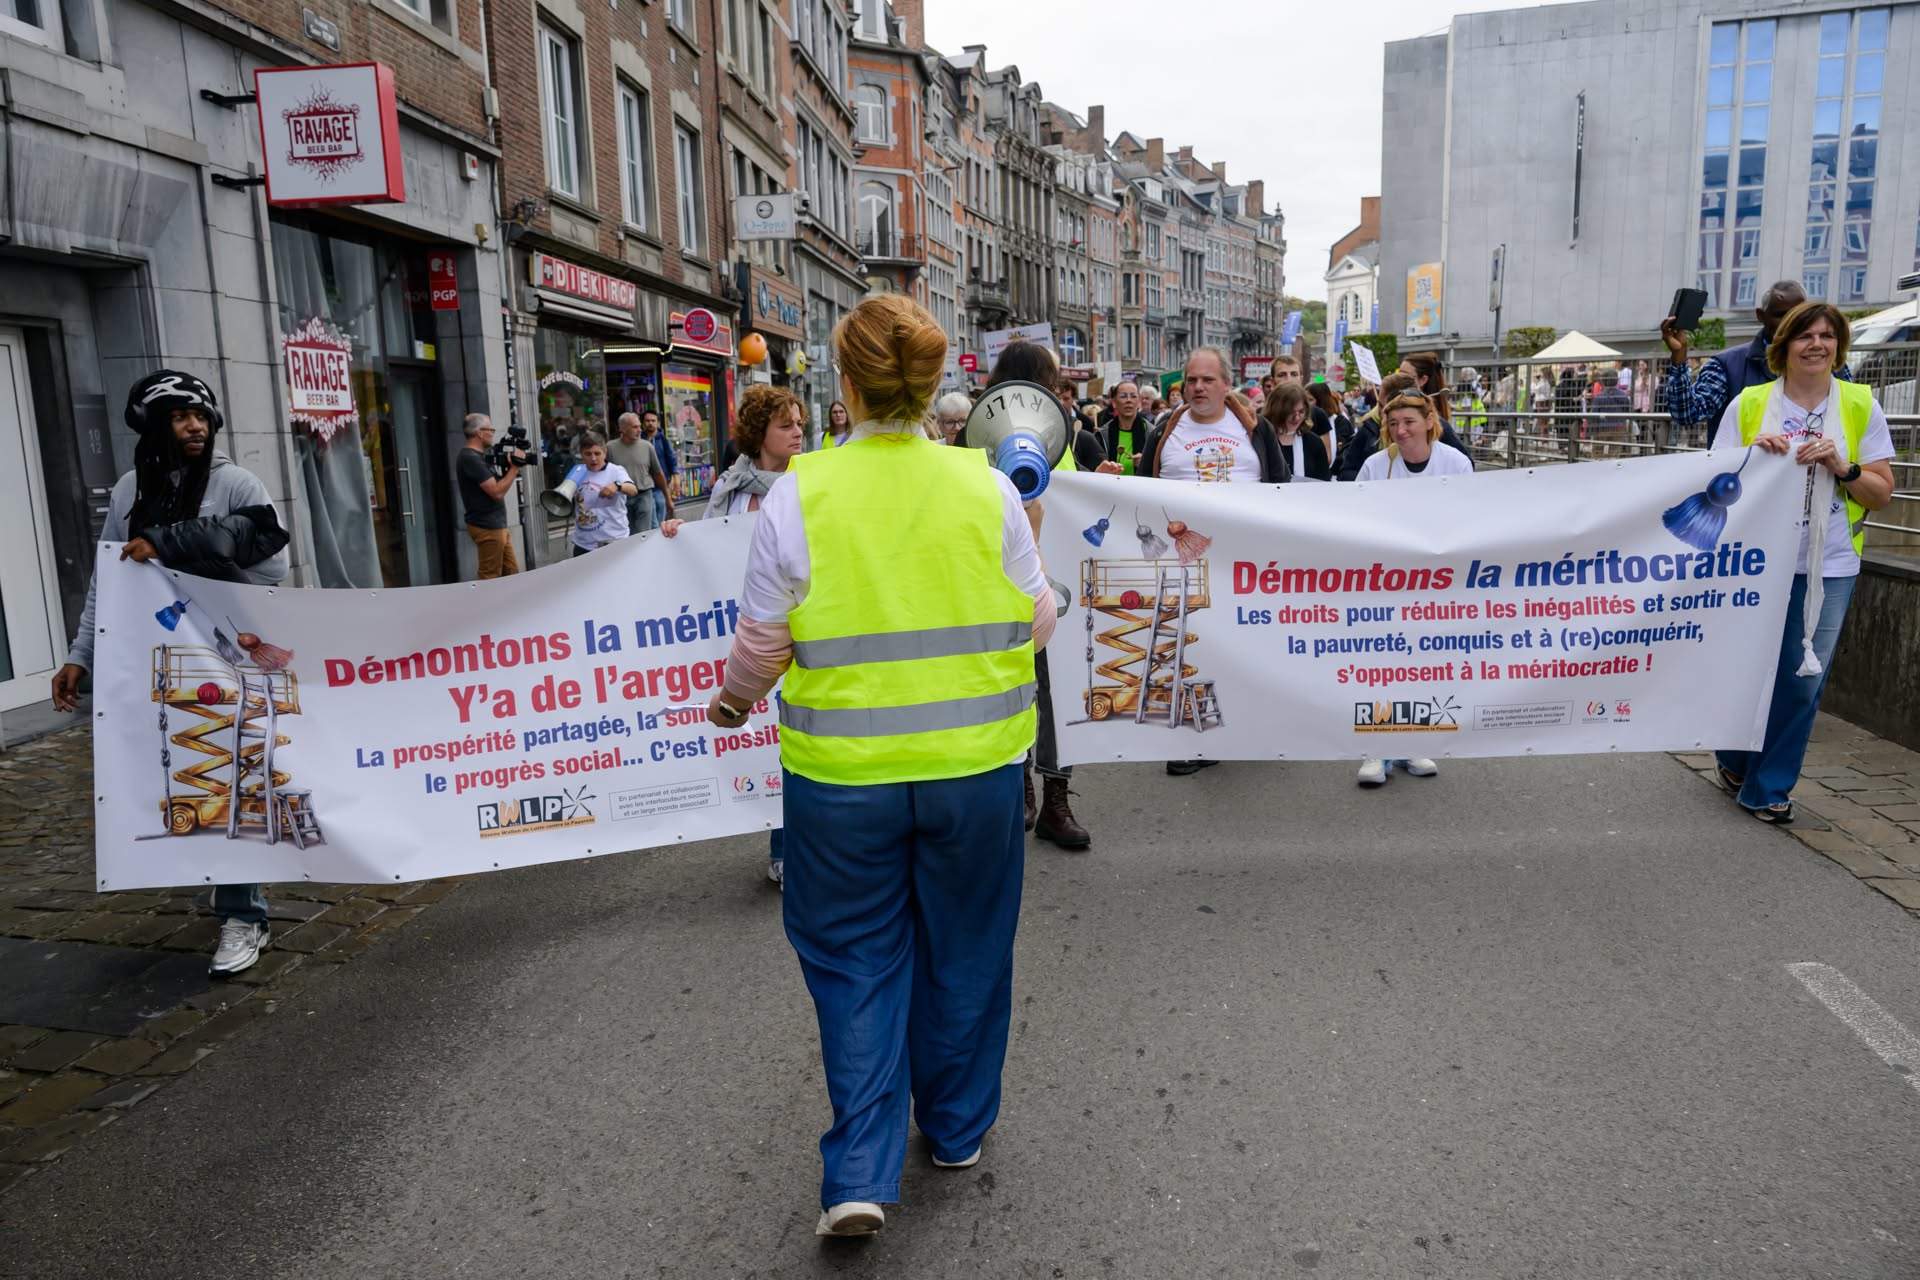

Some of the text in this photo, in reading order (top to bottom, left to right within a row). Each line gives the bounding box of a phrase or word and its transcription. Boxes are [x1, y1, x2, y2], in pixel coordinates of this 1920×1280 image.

[293, 116, 352, 144] RAVAGE
[307, 144, 343, 154] BEER BAR
[433, 290, 456, 301] PGP
[555, 263, 636, 307] DIEKIRCH
[291, 350, 347, 391] RAVAGE
[306, 394, 339, 406] BEER BAR
[986, 392, 1043, 419] RWLP
[88, 429, 100, 441] 10
[90, 442, 103, 454] 12
[1233, 542, 1765, 595] Démontons la méritocratie
[1237, 587, 1760, 626] Les droits pour réduire les inégalités et sortir de
[325, 599, 740, 687] Démontons la mérit
[1288, 621, 1704, 658] la pauvreté, conquis et à (re)conquérir,
[1337, 653, 1653, 686] s'opposent à la méritocratie !
[448, 684, 517, 723] Y'a
[531, 675, 581, 713] de
[1355, 700, 1431, 725] RWLP
[356, 748, 384, 768] La
[393, 729, 516, 769] prospérité
[524, 715, 631, 752] partagée,
[637, 711, 659, 732] la
[425, 773, 447, 794] le
[455, 760, 545, 794] progrès
[553, 747, 643, 776] social...
[650, 736, 708, 762] C'est
[628, 791, 661, 802] partenariat
[670, 784, 710, 794] collaboration
[640, 806, 656, 814] large
[680, 799, 709, 808] associatif
[645, 795, 686, 805] interlocuteurs
[478, 797, 562, 830] RWLP
